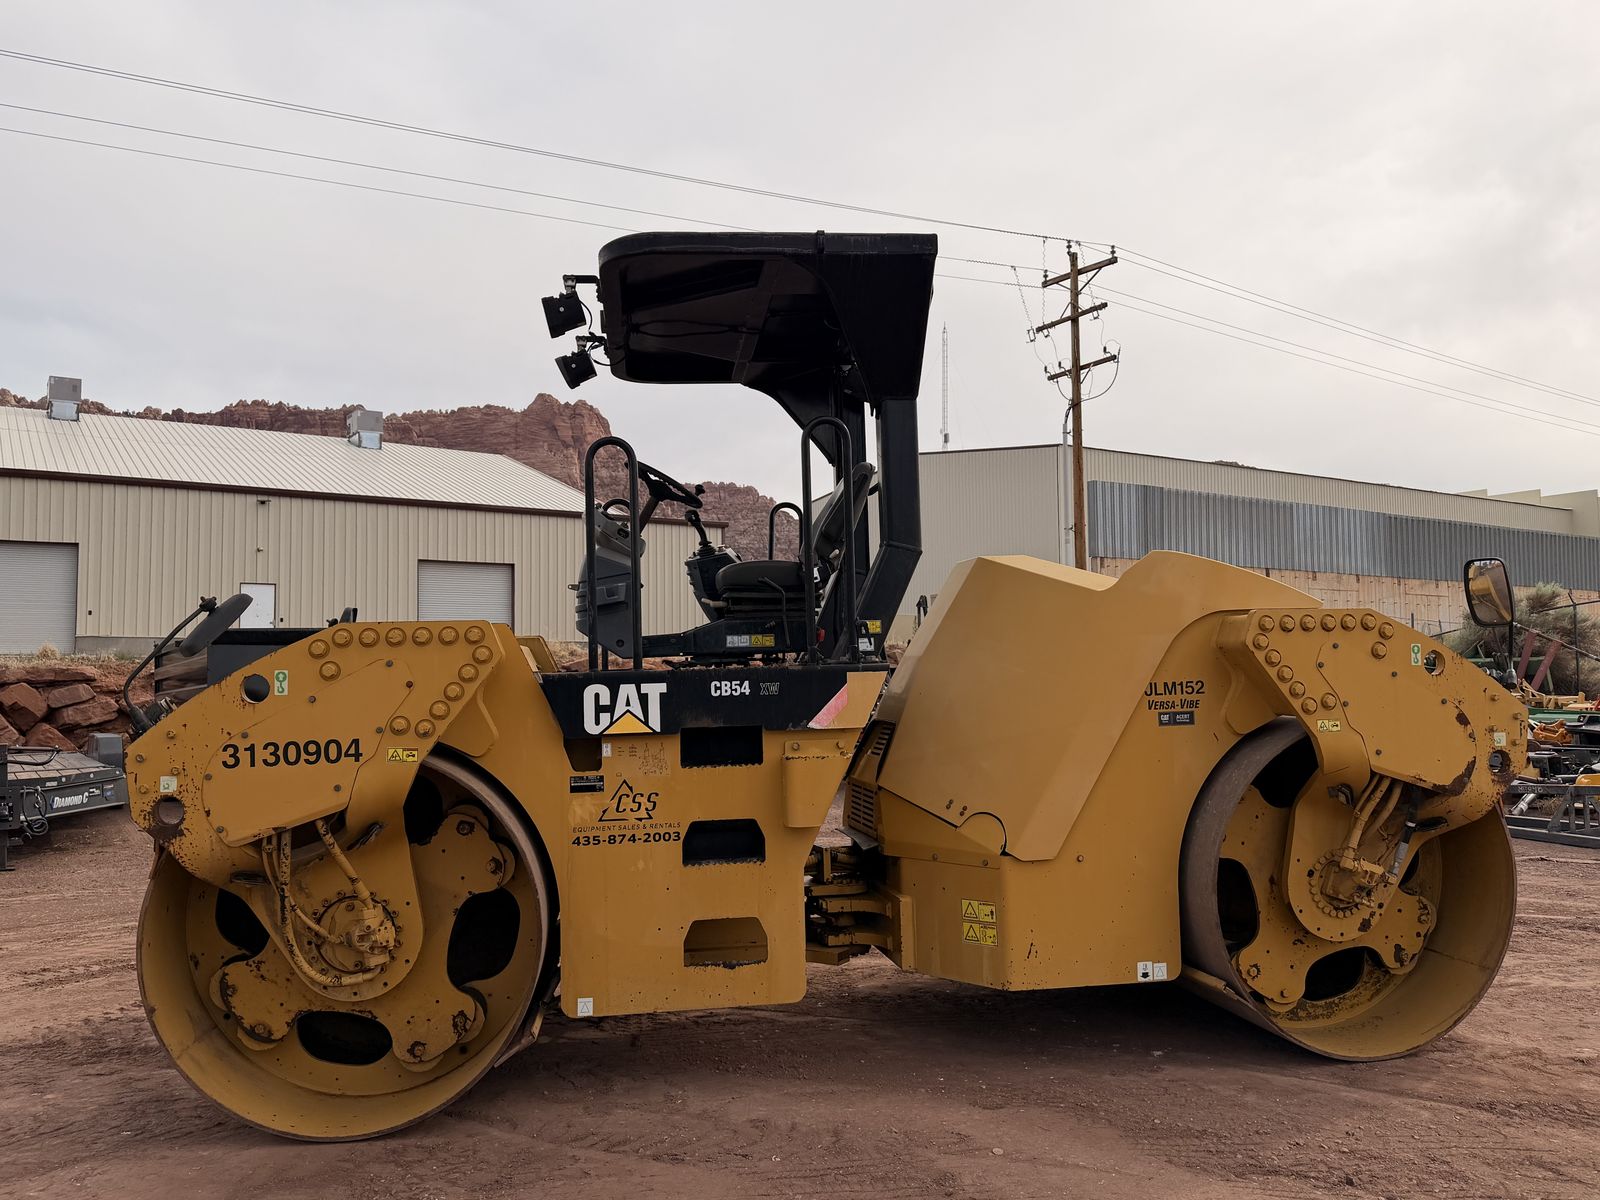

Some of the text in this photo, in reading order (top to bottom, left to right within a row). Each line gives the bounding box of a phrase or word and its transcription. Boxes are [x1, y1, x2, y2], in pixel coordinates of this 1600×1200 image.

[710, 680, 780, 697] CB54 XW
[1144, 680, 1206, 696] JLM152
[583, 682, 667, 735] CAT
[221, 738, 363, 769] 3130904
[615, 792, 660, 814] CSS
[572, 821, 681, 833] EQUIPMENT SALES & RENTALS
[571, 831, 681, 847] 435-874-2003
